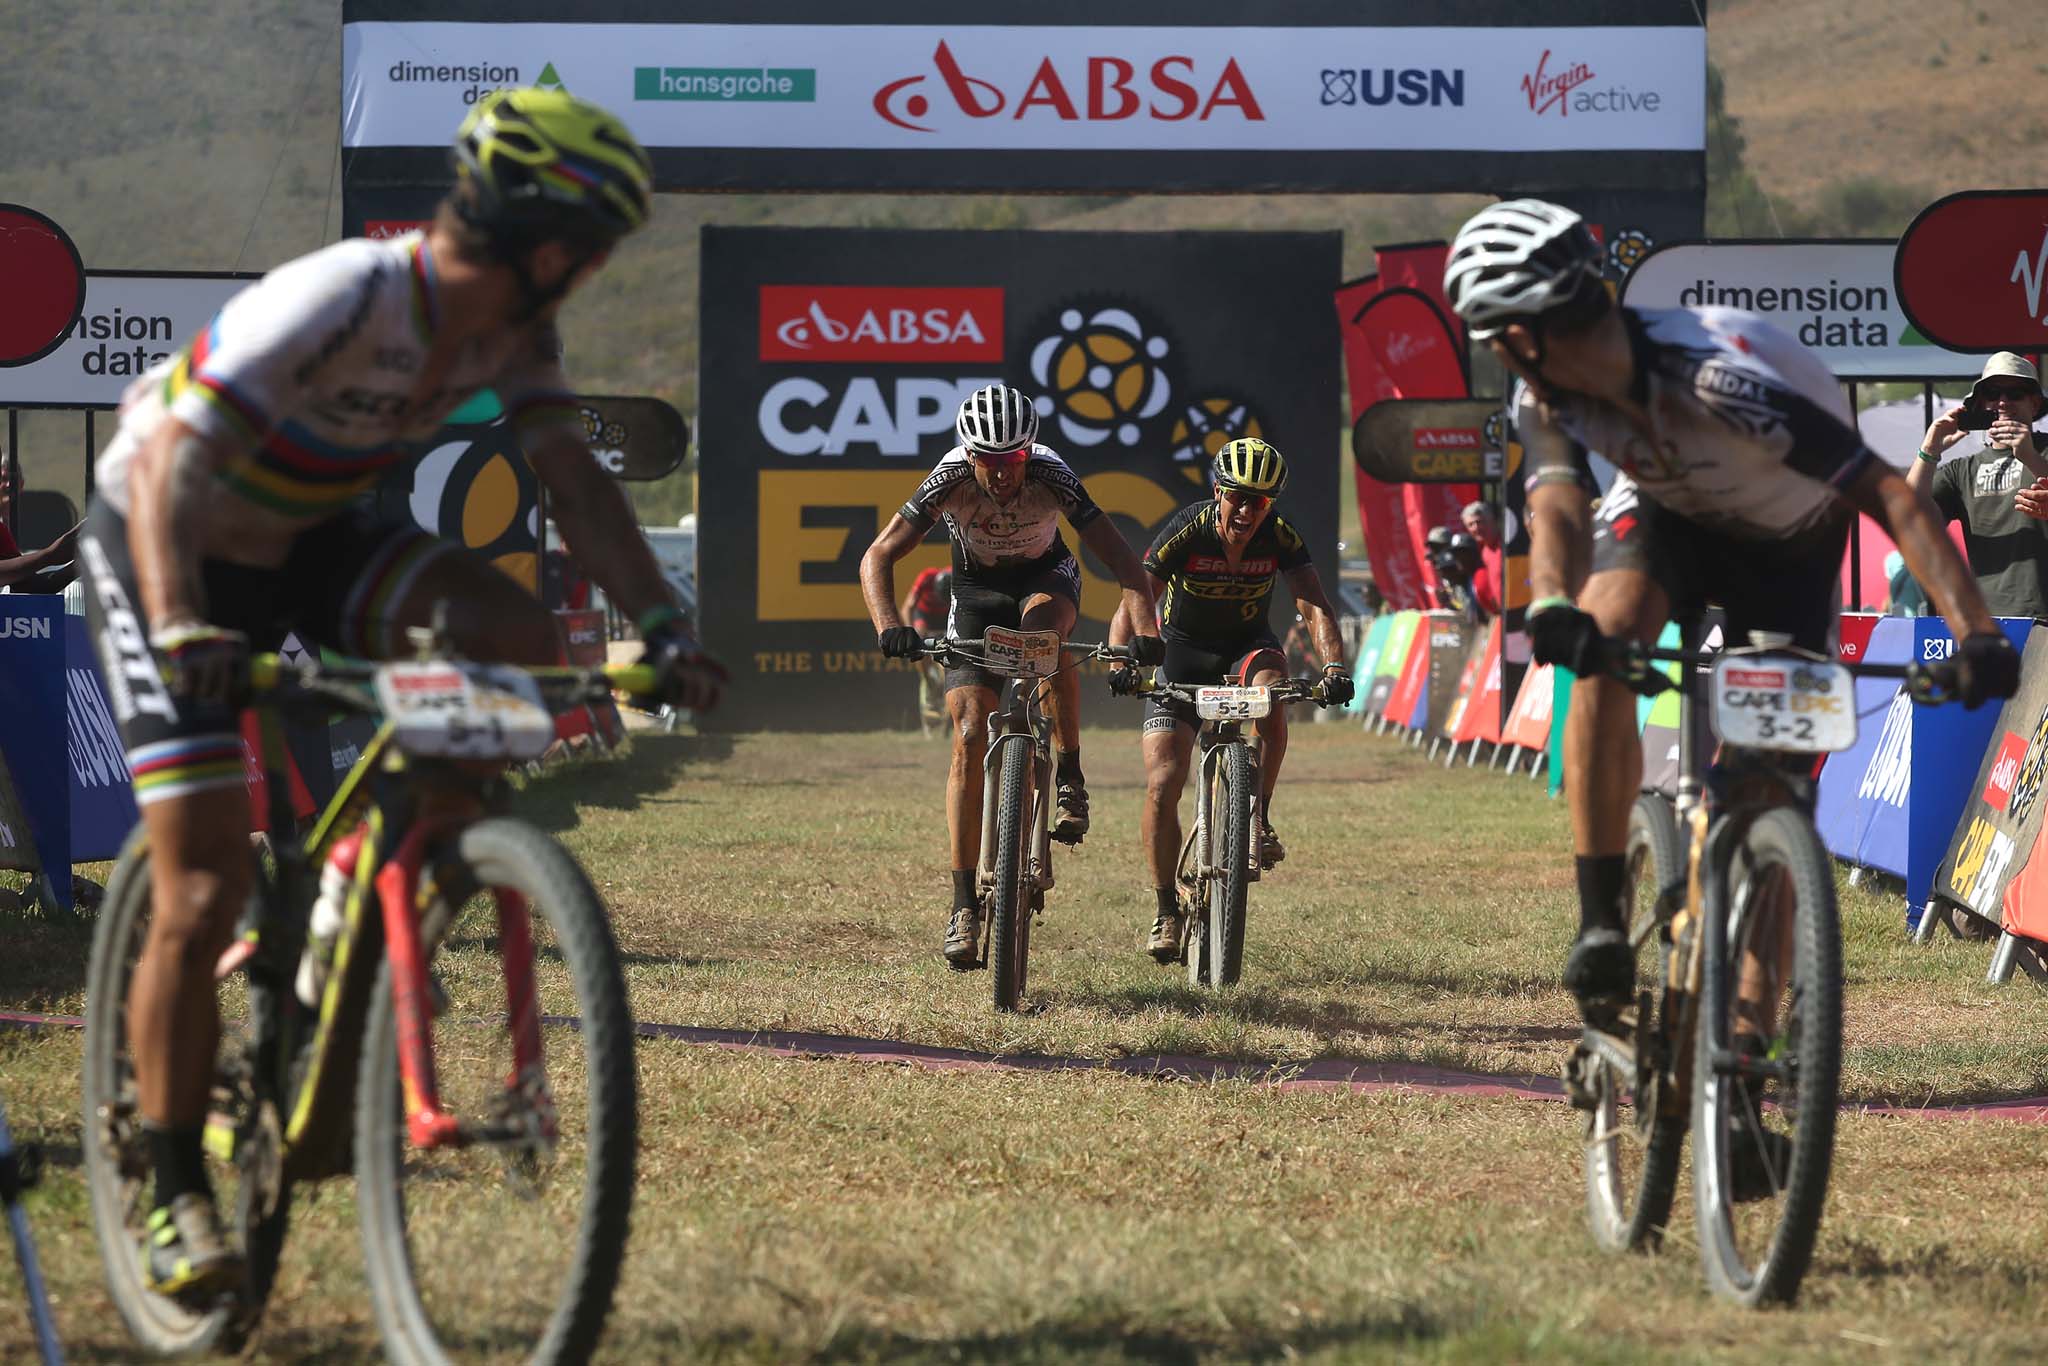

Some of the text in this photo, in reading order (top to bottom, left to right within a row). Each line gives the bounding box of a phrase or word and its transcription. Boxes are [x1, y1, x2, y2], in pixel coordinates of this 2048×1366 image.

[389, 61, 519, 82] dimension
[659, 66, 793, 98] hansgrohe
[1520, 50, 1596, 117] Virgin
[1013, 56, 1265, 121] ABSA
[1361, 69, 1464, 107] USN
[1574, 86, 1661, 112] active
[1680, 280, 1888, 312] dimension
[851, 309, 985, 344] ABSA
[1799, 316, 1889, 347] data
[1412, 453, 1480, 476] CAPE
[755, 653, 812, 673] THE
[1219, 701, 1249, 716] 5-2
[1724, 690, 1785, 710] CAPE
[1757, 715, 1815, 741] 3-2
